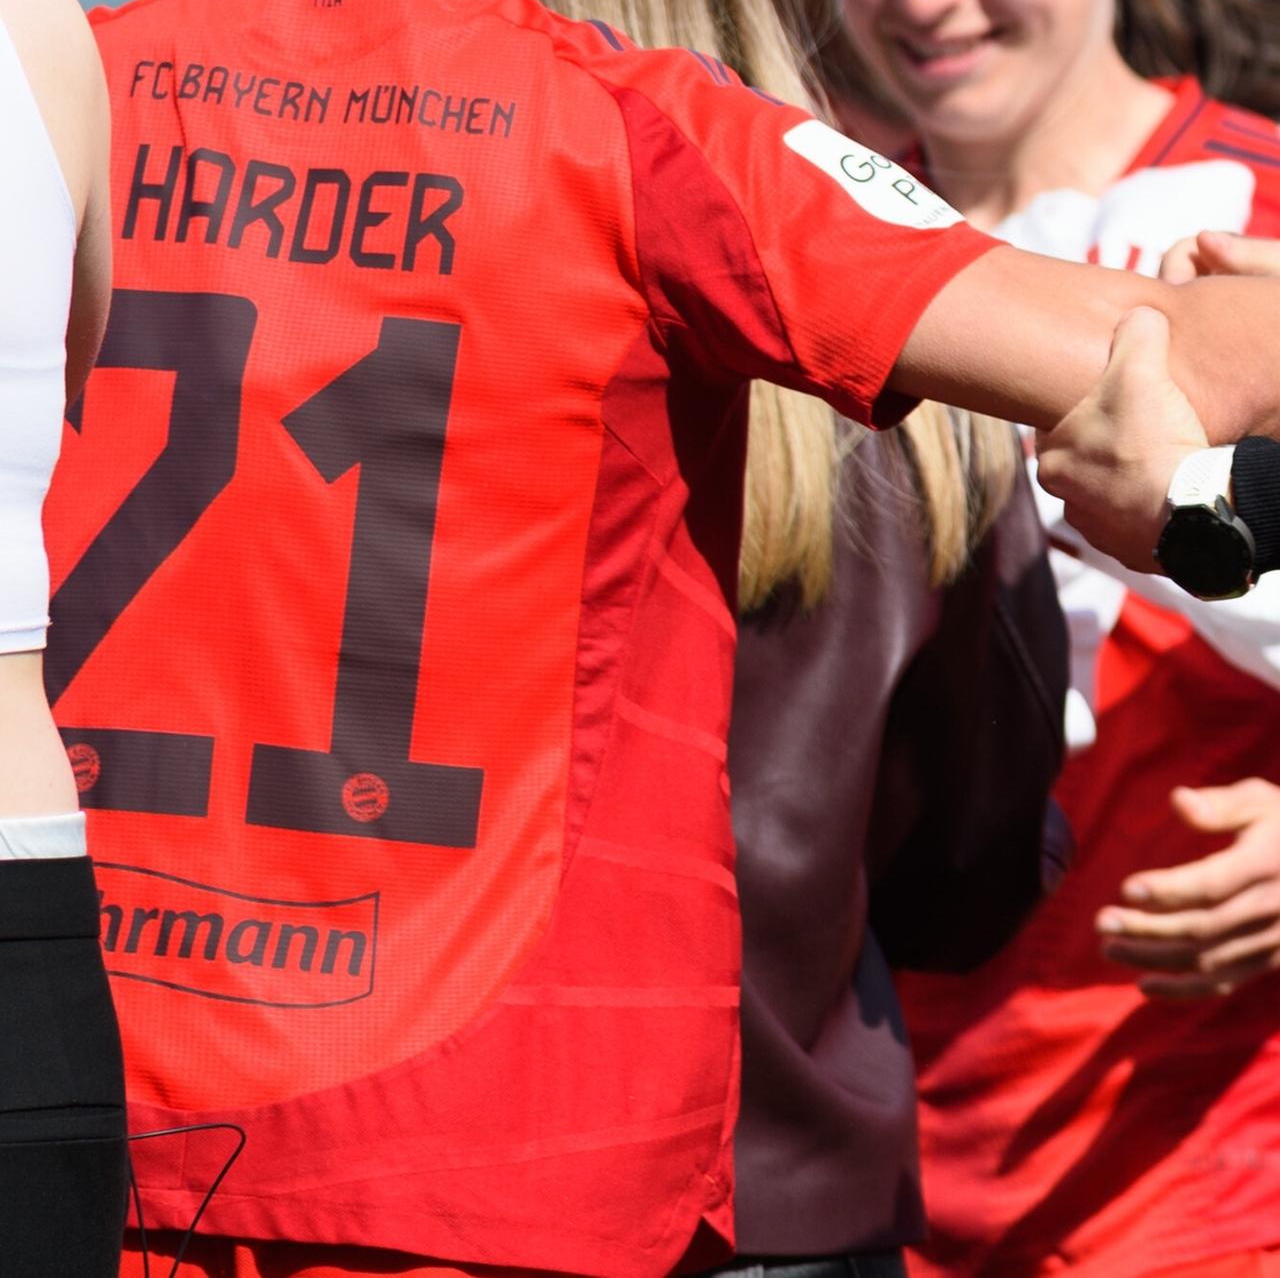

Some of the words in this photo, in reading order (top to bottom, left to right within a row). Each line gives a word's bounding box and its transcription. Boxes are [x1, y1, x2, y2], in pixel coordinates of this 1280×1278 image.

[130, 61, 173, 99] FC
[178, 63, 332, 124] BAYERN
[346, 85, 517, 139] MÜNCHEN
[121, 143, 465, 276] HARDER
[43, 288, 485, 849] 21
[98, 888, 368, 977] hrmann
